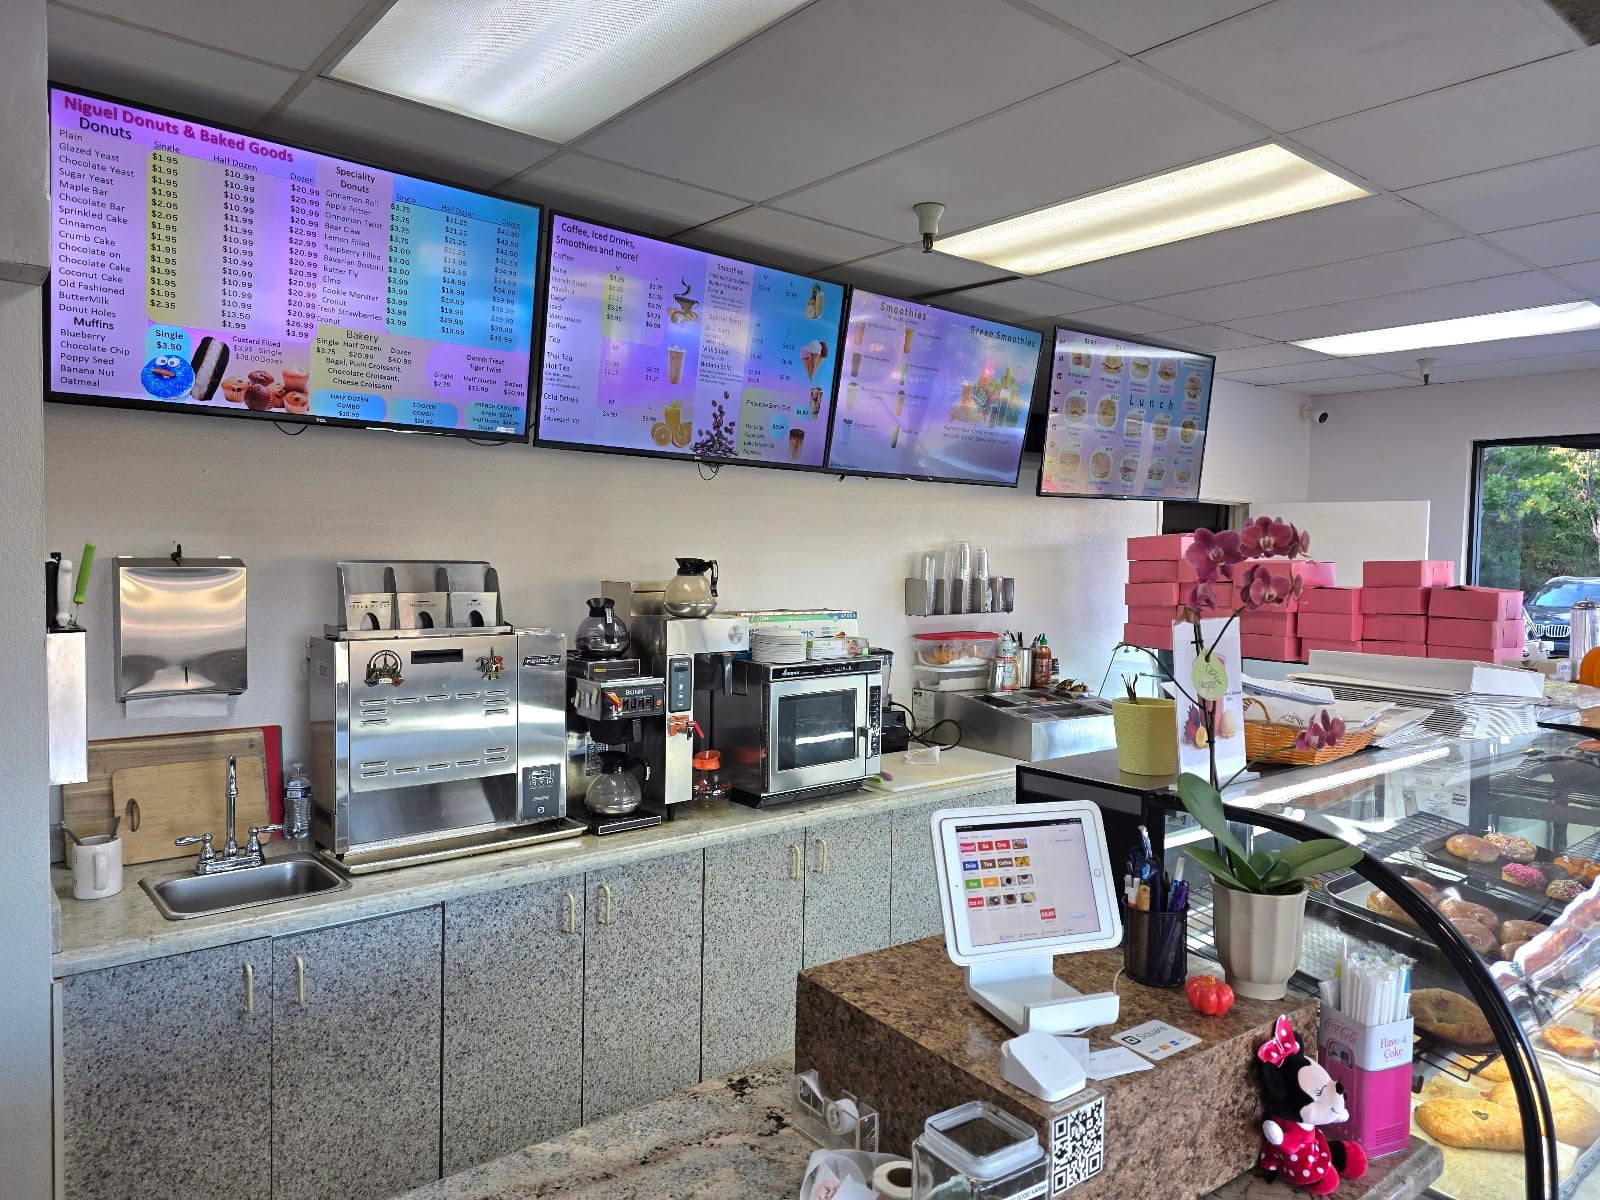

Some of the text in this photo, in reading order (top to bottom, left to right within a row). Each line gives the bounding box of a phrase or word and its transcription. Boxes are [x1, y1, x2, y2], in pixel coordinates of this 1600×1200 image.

[64, 95, 294, 163] Niguel Donuts & Baked Goods
[80, 117, 132, 139] Donuts
[60, 130, 82, 141] Plain
[59, 143, 119, 162] Glazed Yeast
[154, 141, 180, 154] Single
[153, 153, 178, 164] $1.95
[213, 155, 258, 172] Half Dozen
[59, 155, 135, 178] Chocolate Yeast
[152, 164, 178, 176] $1.95
[59, 168, 114, 185] Sugar Yeast
[224, 169, 255, 181] $10.99
[291, 173, 314, 183] Dozen
[336, 167, 375, 183] Speciality
[152, 176, 177, 187] $1.95
[224, 180, 254, 192] $10.99
[340, 180, 369, 193] Donuts
[59, 180, 108, 197] Maple Bar
[152, 187, 177, 198] $1.95
[291, 184, 319, 196] $20.99
[59, 193, 125, 212] Chocolate Bar
[224, 191, 254, 203] $10.99
[291, 195, 319, 206] $20.99
[152, 199, 178, 210] $2.05
[224, 202, 254, 214] $10.99
[391, 203, 411, 213] $3.75
[59, 205, 128, 224] Sprinkled Cake
[152, 210, 178, 221] $2.05
[291, 206, 319, 217] $20.99
[224, 213, 253, 224] $11.99
[290, 216, 319, 227] $20.99
[325, 212, 383, 229] Cinnamon Twist
[391, 214, 410, 224] $3.75
[59, 218, 107, 232] Cinnamon
[151, 221, 177, 232] $1.95
[224, 224, 252, 235] $11.99
[390, 225, 410, 234] $3.75
[289, 226, 316, 237] $22.99
[561, 223, 635, 249] Coffee, Iced Drinks,
[59, 230, 116, 246] Crumb Cake
[151, 232, 176, 243] $1.95
[223, 235, 253, 246] $10.99
[289, 237, 316, 248] $22.99
[390, 235, 409, 245] $3.75
[59, 243, 105, 257] Chocolate
[151, 244, 176, 254] $1.95
[223, 246, 253, 257] $10.99
[289, 247, 317, 258] $20.99
[389, 246, 410, 255] $3.00
[556, 235, 638, 261] Smoothies and more!
[151, 255, 176, 265] $1.95
[223, 256, 253, 267] $10.99
[389, 256, 410, 265] $3.00
[553, 252, 574, 262] Coffee
[59, 255, 131, 272] Chocolate Cake
[289, 258, 317, 268] $20.99
[59, 267, 123, 284] Coconut Cake
[150, 266, 176, 276] $1.95
[222, 267, 252, 278] $10.99
[289, 268, 317, 278] $20.99
[388, 266, 410, 275] $3.00
[150, 277, 176, 287] $1.95
[222, 278, 252, 288] $10.99
[288, 278, 317, 289] $20.99
[388, 277, 408, 285] $3.99
[59, 279, 125, 295] Old Fashioned
[387, 287, 408, 296] $3.99
[59, 291, 109, 305] ButterMilk
[150, 288, 176, 298] $1.95
[222, 288, 252, 299] $10.99
[288, 288, 316, 299] $20.99
[322, 287, 378, 301] Cookie Monster
[150, 299, 175, 309] $2.35
[222, 299, 252, 309] $10.99
[288, 299, 316, 309] $20.99
[387, 298, 408, 306] $3.99
[59, 303, 116, 318] Donut Holes
[222, 310, 250, 320] $13.50
[288, 309, 315, 319] $20.99
[386, 307, 407, 316] $3.99
[880, 302, 927, 320] Smoothies
[73, 317, 114, 330] Muffins
[222, 320, 246, 329] $1.99
[386, 318, 407, 326] $3.99
[60, 329, 106, 342] Blueberry
[155, 330, 184, 340] Single
[286, 329, 308, 338] $3.99
[347, 330, 378, 343] Bakery
[970, 325, 1036, 347] Green Smoothies
[156, 341, 182, 351] $3.50
[233, 336, 280, 348] Custard Filled
[60, 341, 130, 356] Chocolate Chip
[316, 347, 335, 355] $3.75
[60, 353, 114, 365] Poppy Seed
[547, 352, 560, 360] Thai
[60, 365, 114, 377] Banana Nut
[559, 364, 569, 372] Tea
[60, 377, 100, 387] Oatmeal
[560, 395, 579, 404] Drinks
[1130, 394, 1174, 410] Lunch
[1380, 1037, 1398, 1048] Have
[1384, 1047, 1403, 1059] Coke
